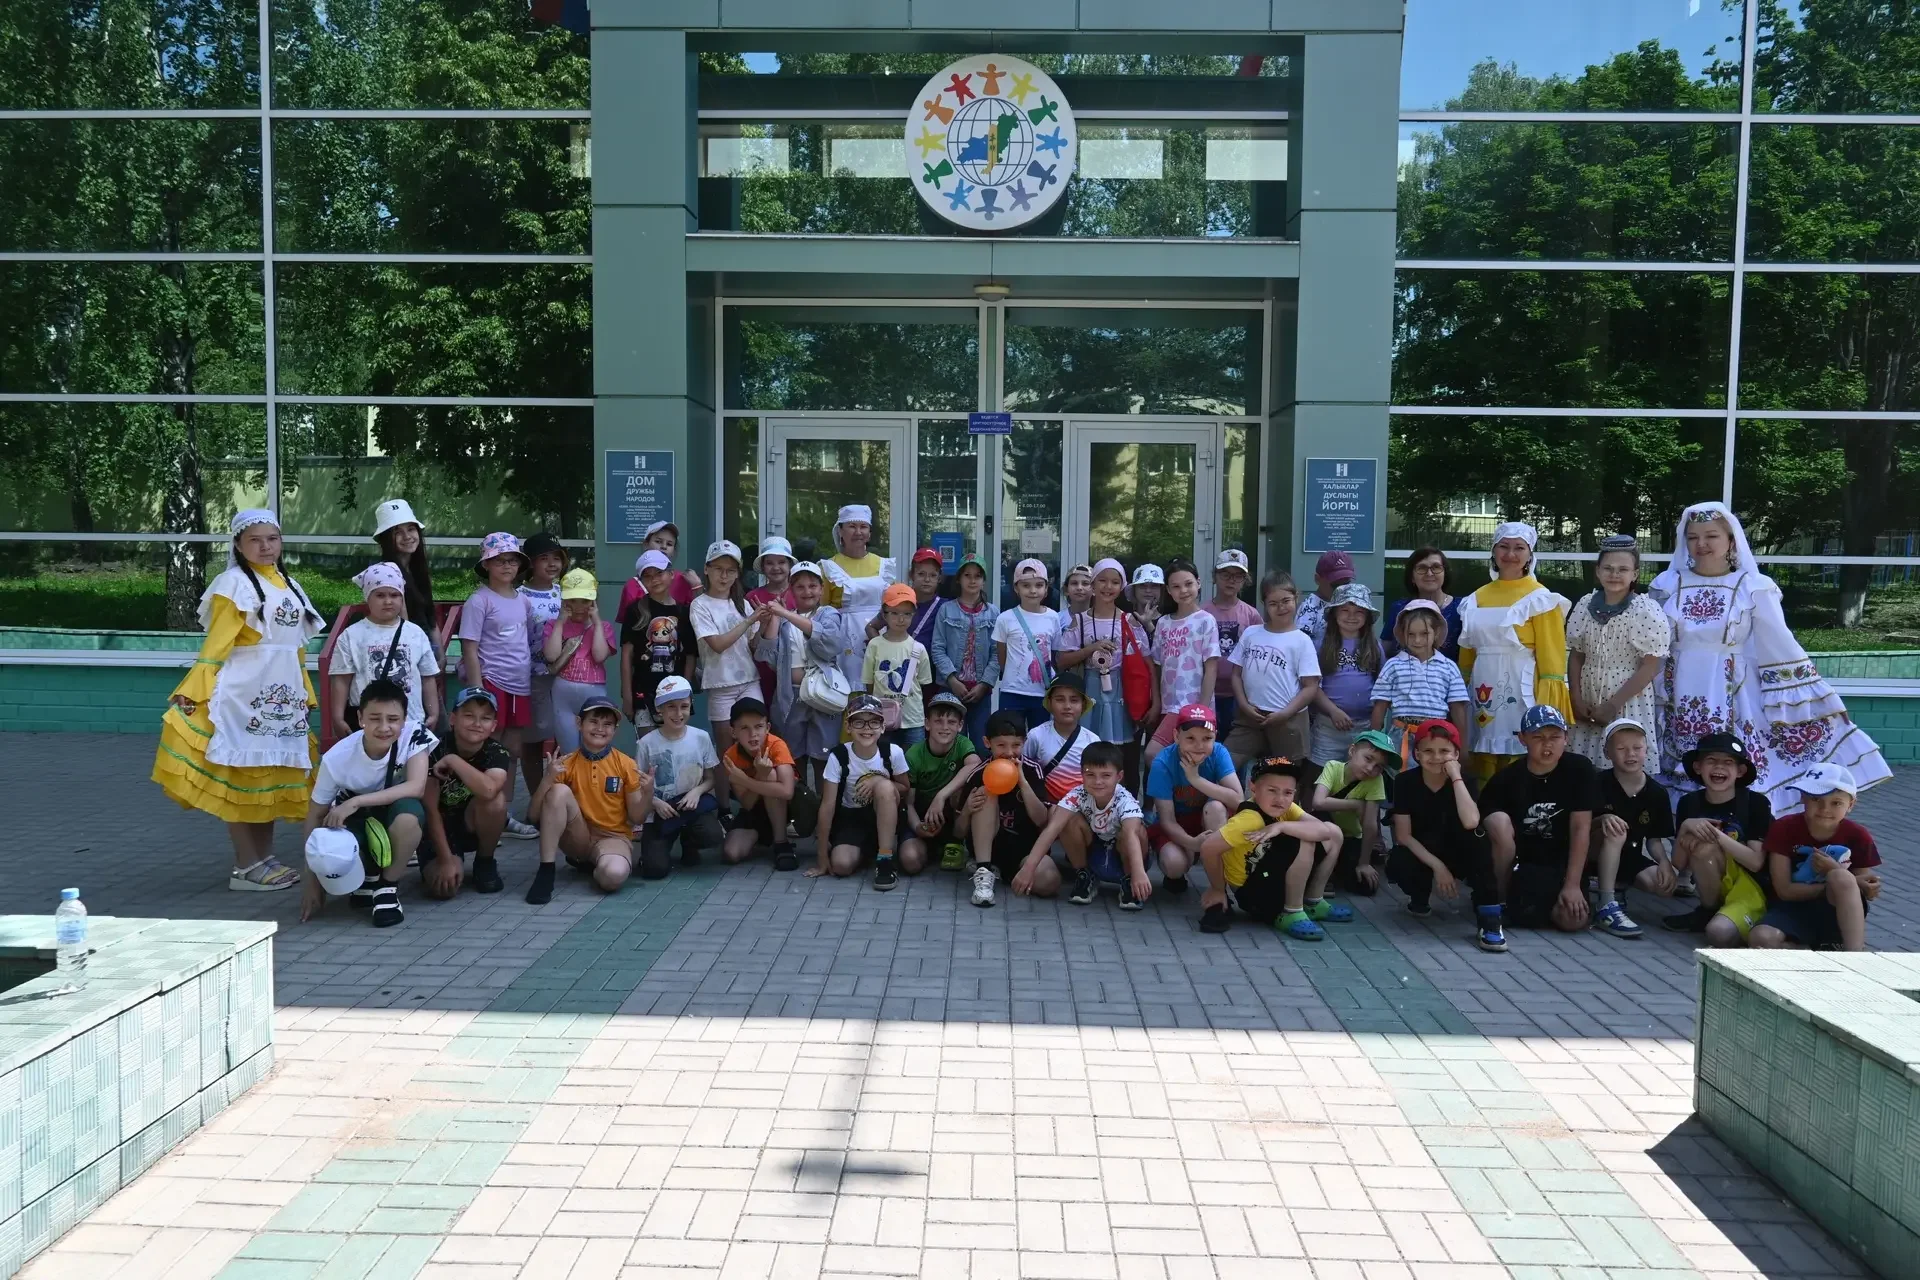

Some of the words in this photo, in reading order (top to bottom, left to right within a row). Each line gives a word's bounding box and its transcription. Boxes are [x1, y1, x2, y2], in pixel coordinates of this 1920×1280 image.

[626, 476, 655, 488] ДОМ
[1323, 492, 1359, 500] ДУСЛЫГЫ
[1322, 500, 1359, 511] ЙОРТЫ
[1168, 626, 1189, 638] KIND
[1270, 654, 1287, 670] LIFE
